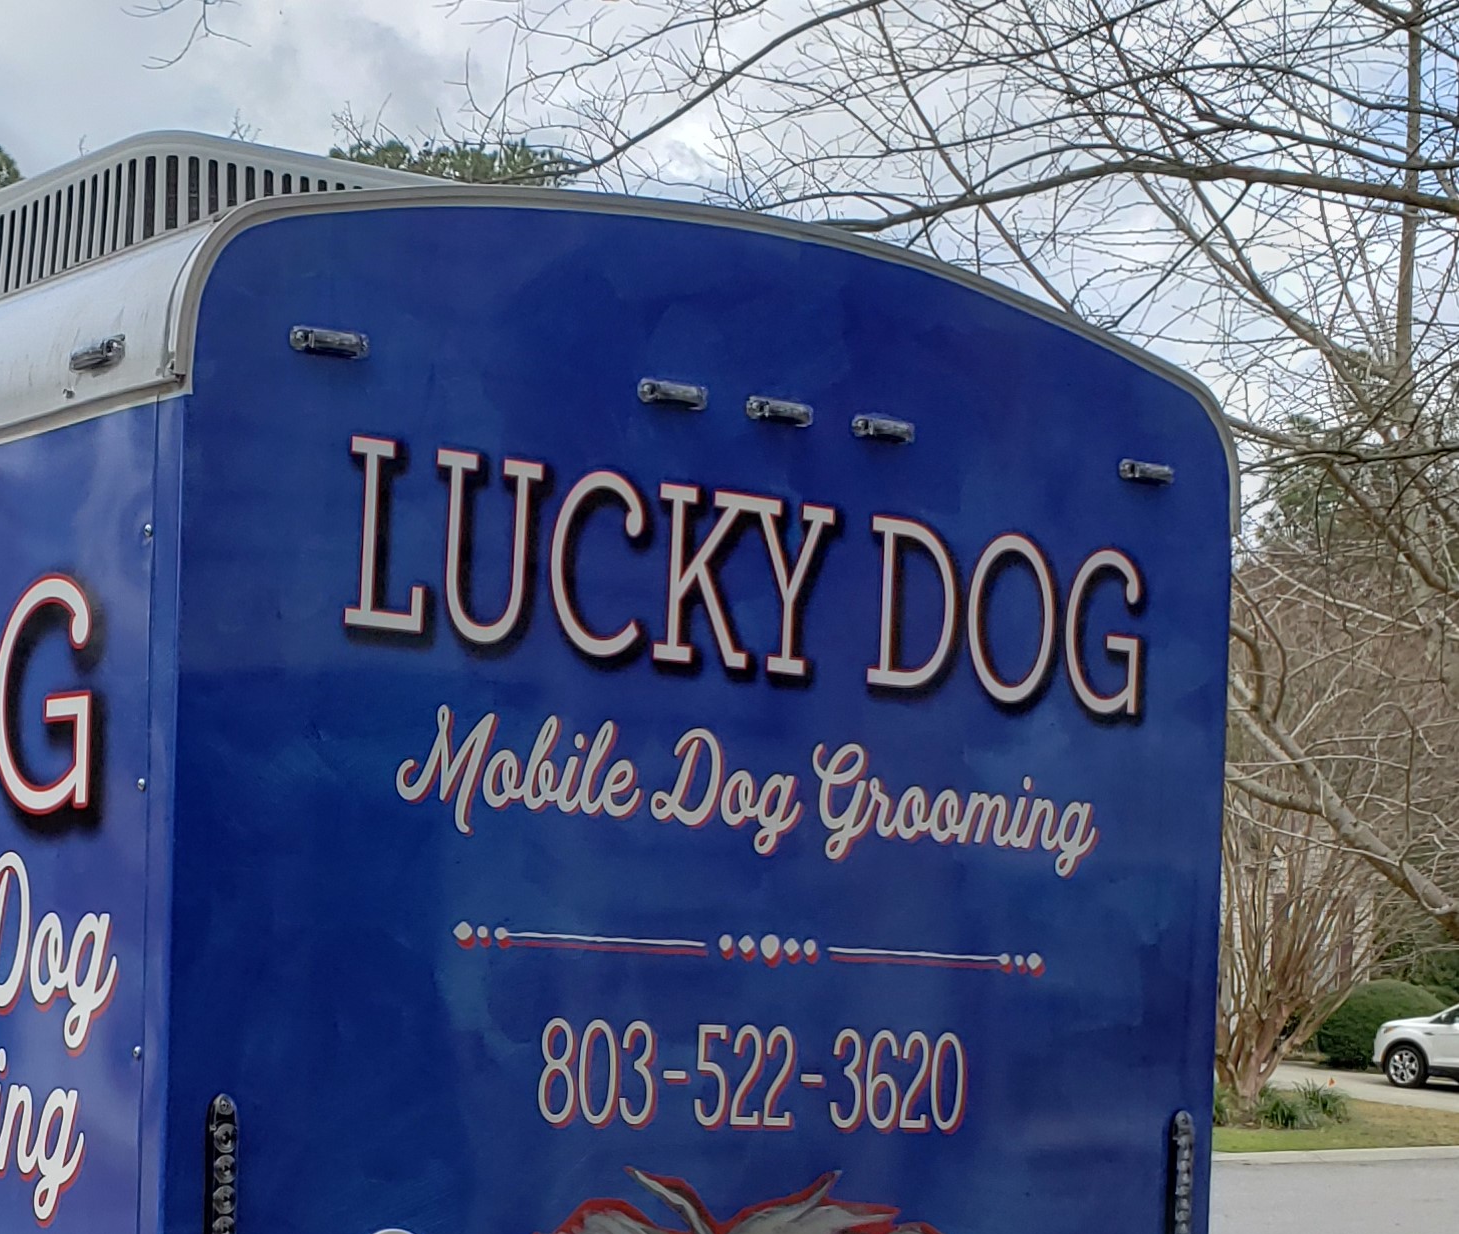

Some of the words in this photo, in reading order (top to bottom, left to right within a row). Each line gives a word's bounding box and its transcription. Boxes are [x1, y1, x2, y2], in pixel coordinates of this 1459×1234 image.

[343, 433, 837, 679] LUCKY
[864, 512, 1144, 717] DOG
[394, 704, 642, 835] Mobile
[649, 726, 801, 857] Dog
[812, 741, 1098, 878] Grooming
[536, 1015, 969, 1134] 803-522-3620
